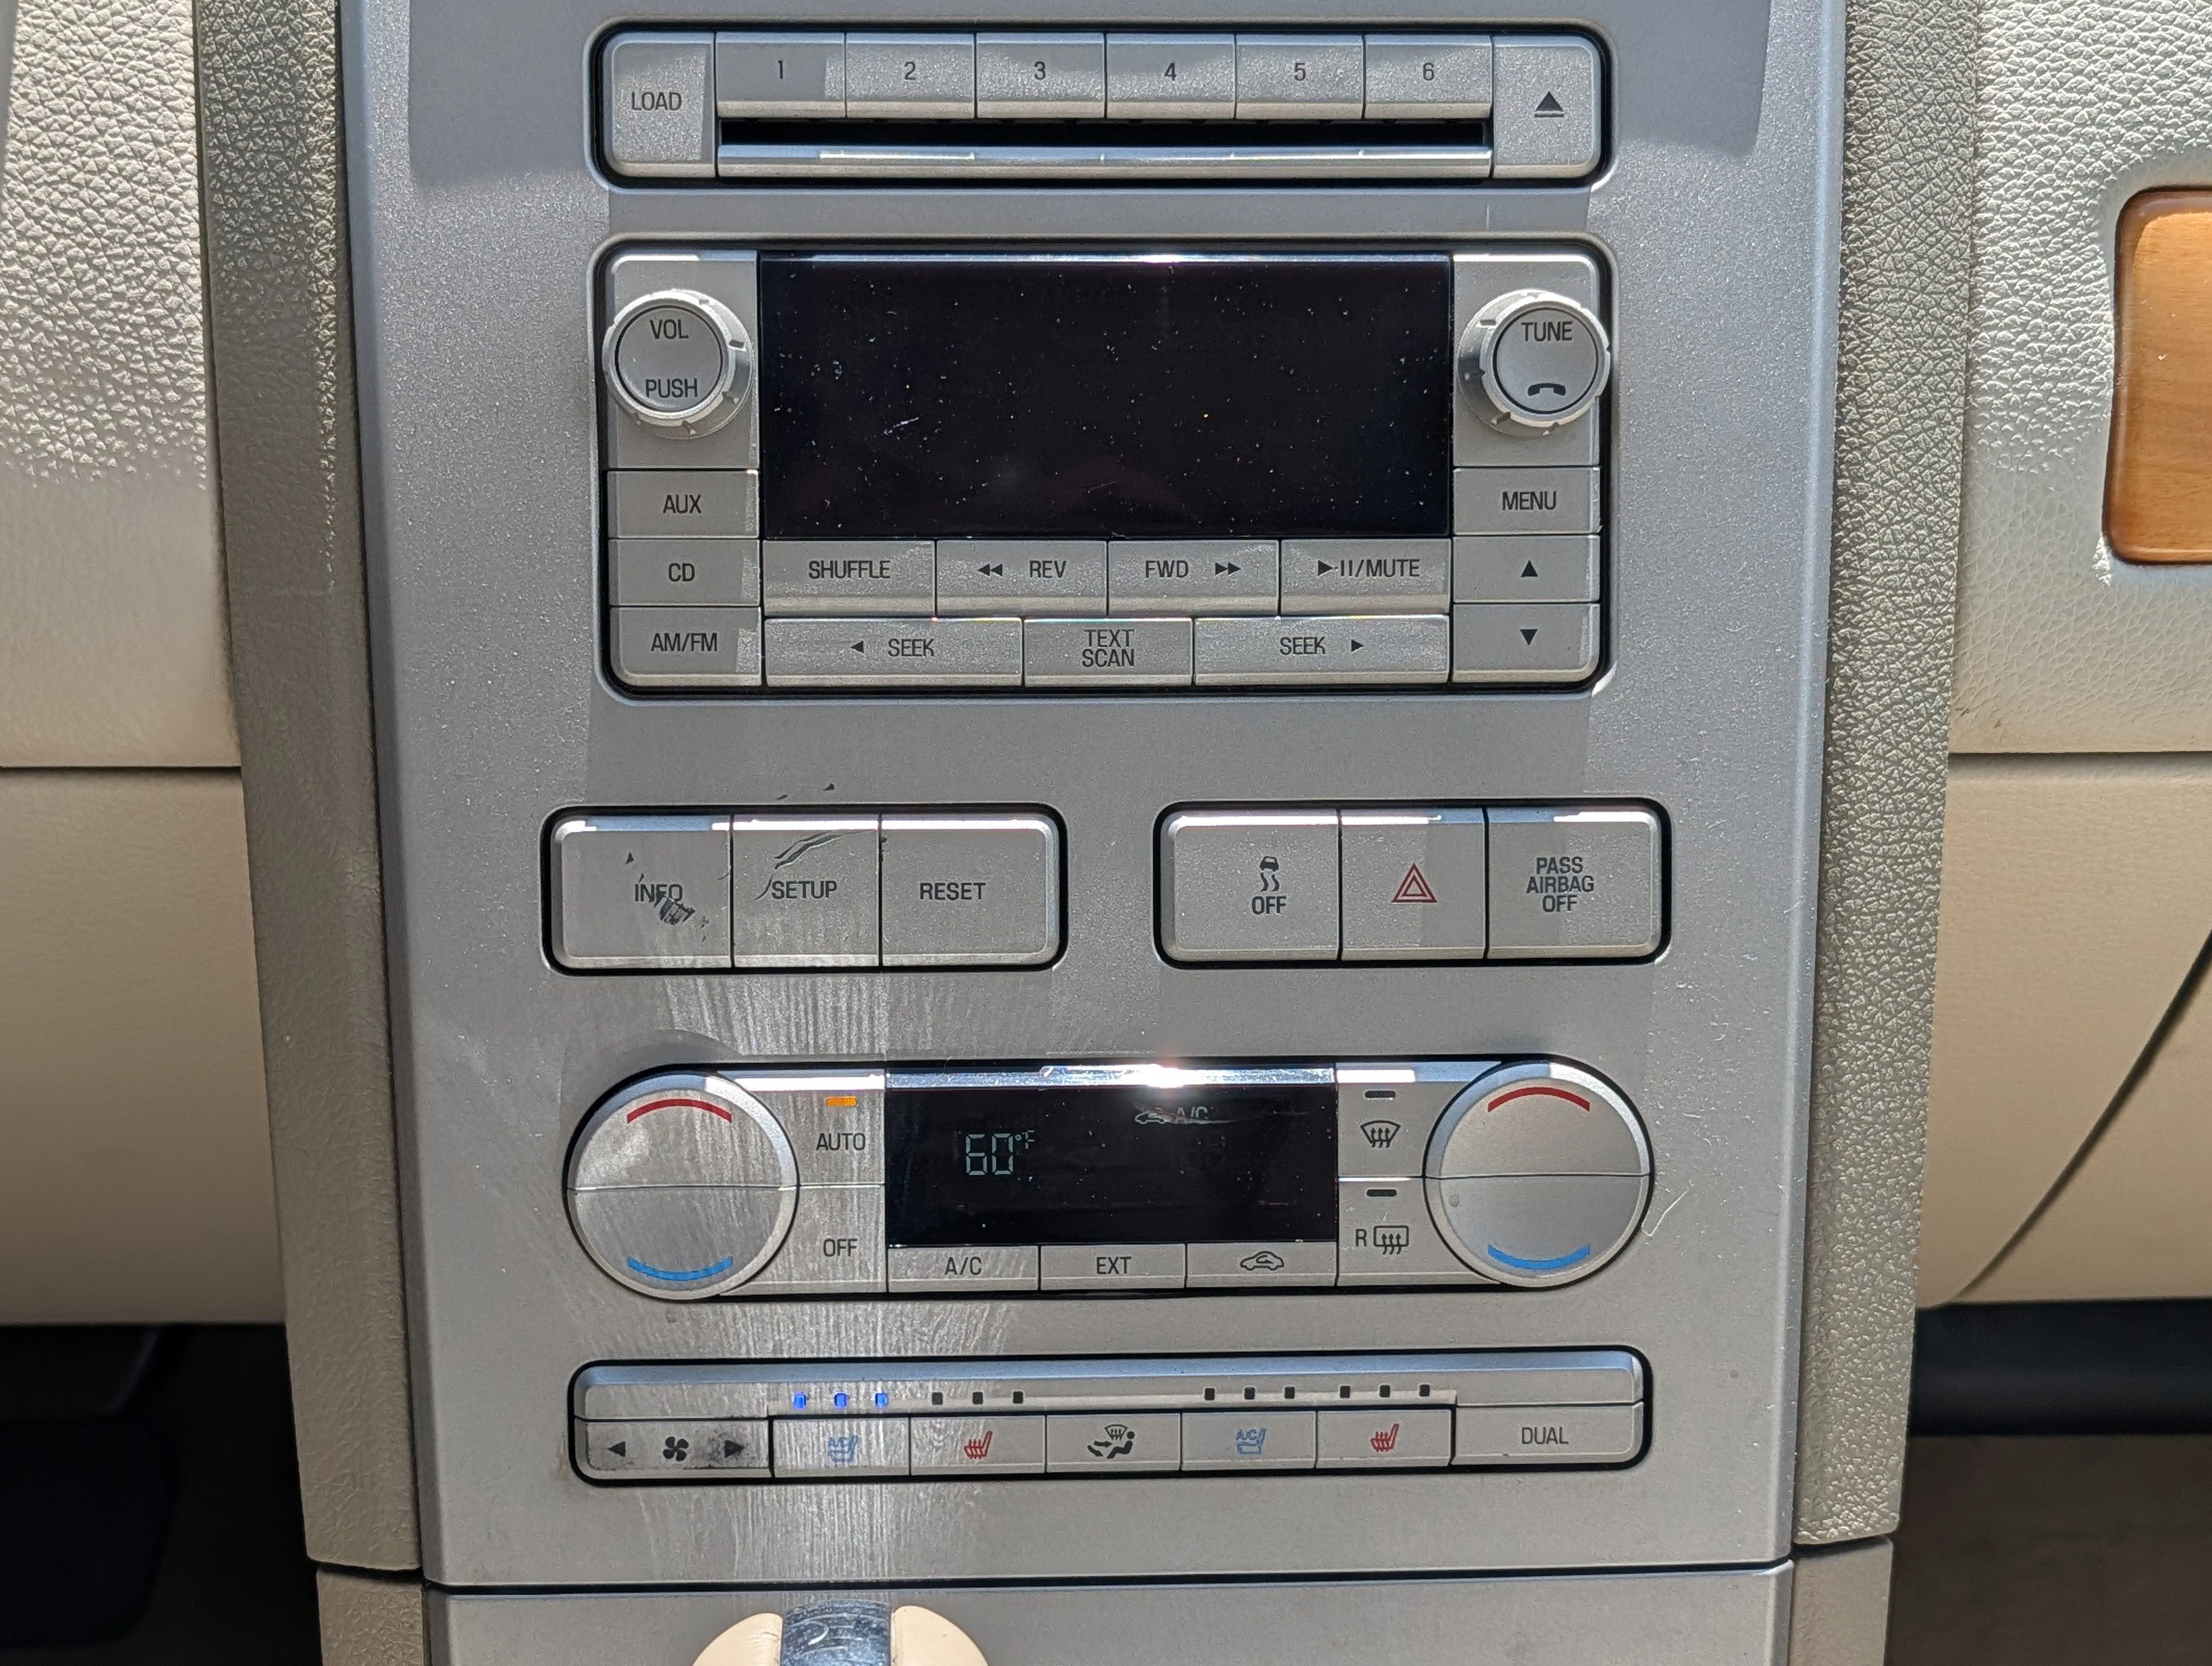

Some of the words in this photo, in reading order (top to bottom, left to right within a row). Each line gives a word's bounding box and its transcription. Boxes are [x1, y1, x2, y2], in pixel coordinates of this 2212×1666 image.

[777, 60, 783, 80] 1
[904, 61, 916, 81] 2
[1034, 60, 1046, 80] 3
[1164, 62, 1177, 81] 4
[1294, 62, 1307, 81] 5
[1423, 62, 1435, 81] 6
[631, 91, 682, 111] LOAD
[650, 319, 689, 339] VOL
[1521, 321, 1573, 342] TUNE
[645, 377, 698, 398] PUSH
[663, 494, 702, 514] AUX
[1502, 490, 1557, 511] MENU
[668, 562, 695, 582] CD
[808, 560, 891, 580] SHUFFLE
[1029, 560, 1067, 579] REV
[1145, 560, 1189, 578] FWD
[651, 632, 718, 652] AM/FM
[888, 638, 935, 657] SEEK
[1084, 629, 1135, 648] TEXT
[1279, 636, 1326, 656] SEEK
[1082, 649, 1135, 668] SCAN
[1536, 856, 1584, 875] PASS
[635, 883, 683, 903] INFO
[771, 880, 838, 900] SETUP
[919, 882, 986, 901] RESET
[1526, 875, 1594, 894] AIRBAG
[1251, 895, 1287, 915] OFF
[1542, 894, 1578, 913] OFF
[816, 1132, 866, 1151] AUTO
[1355, 1228, 1367, 1247] R
[823, 1238, 858, 1257] OFF
[944, 1256, 982, 1276] A/C
[1096, 1256, 1132, 1275] EXT
[1521, 1426, 1569, 1445] DUAL
